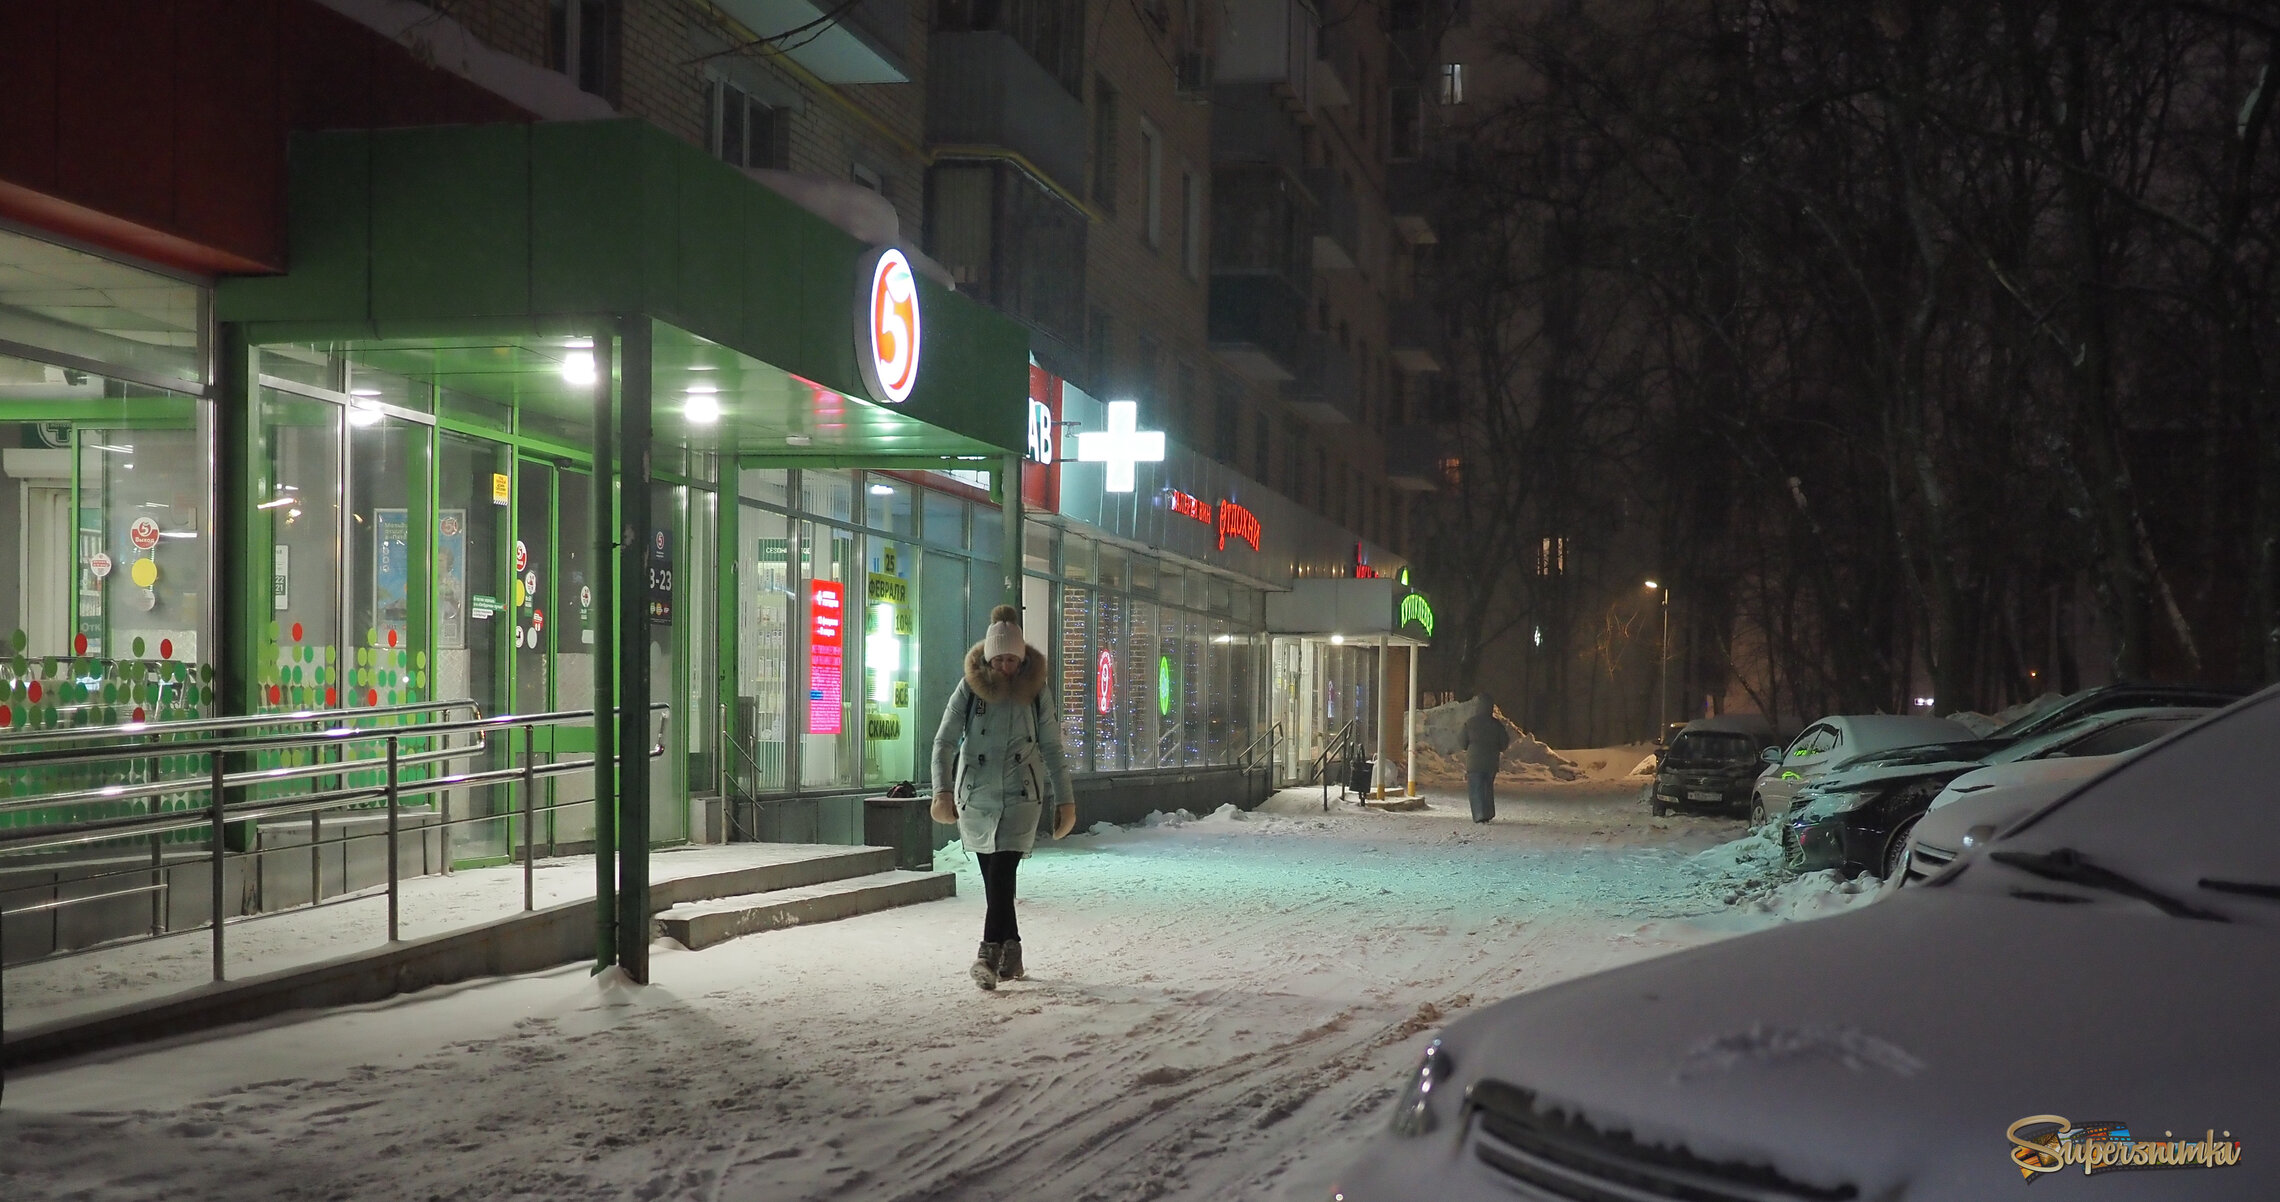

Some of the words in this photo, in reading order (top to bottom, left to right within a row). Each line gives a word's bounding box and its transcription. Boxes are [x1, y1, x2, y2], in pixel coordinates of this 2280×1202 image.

[885, 554, 895, 573] 25
[868, 579, 906, 602] ФЕВРАЛЯ
[868, 719, 901, 740] СКИДКА
